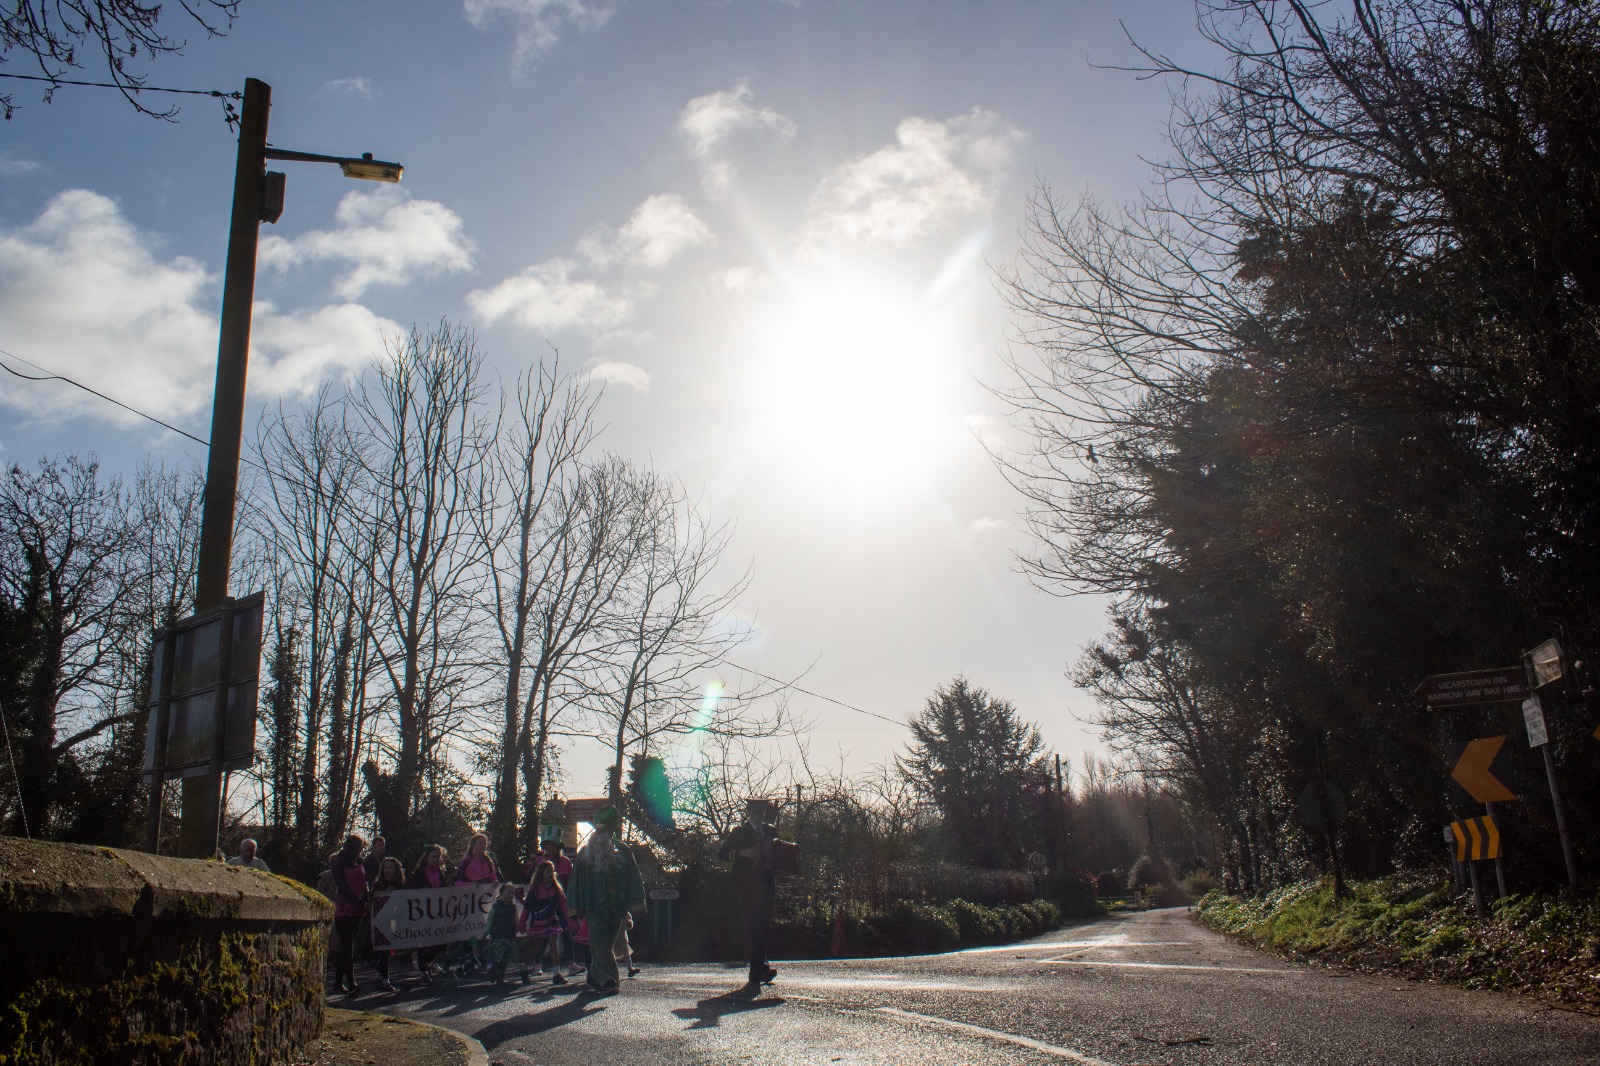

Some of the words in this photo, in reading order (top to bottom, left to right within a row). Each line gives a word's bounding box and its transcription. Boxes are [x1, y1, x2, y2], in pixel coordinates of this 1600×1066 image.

[1437, 677, 1491, 690] VICARSTOWN
[1493, 675, 1508, 684] INN
[1427, 690, 1463, 702] BARROW
[1464, 688, 1482, 698] WAY
[1484, 686, 1501, 696] BIKE
[1502, 684, 1521, 694] HIRE
[434, 925, 445, 938] of
